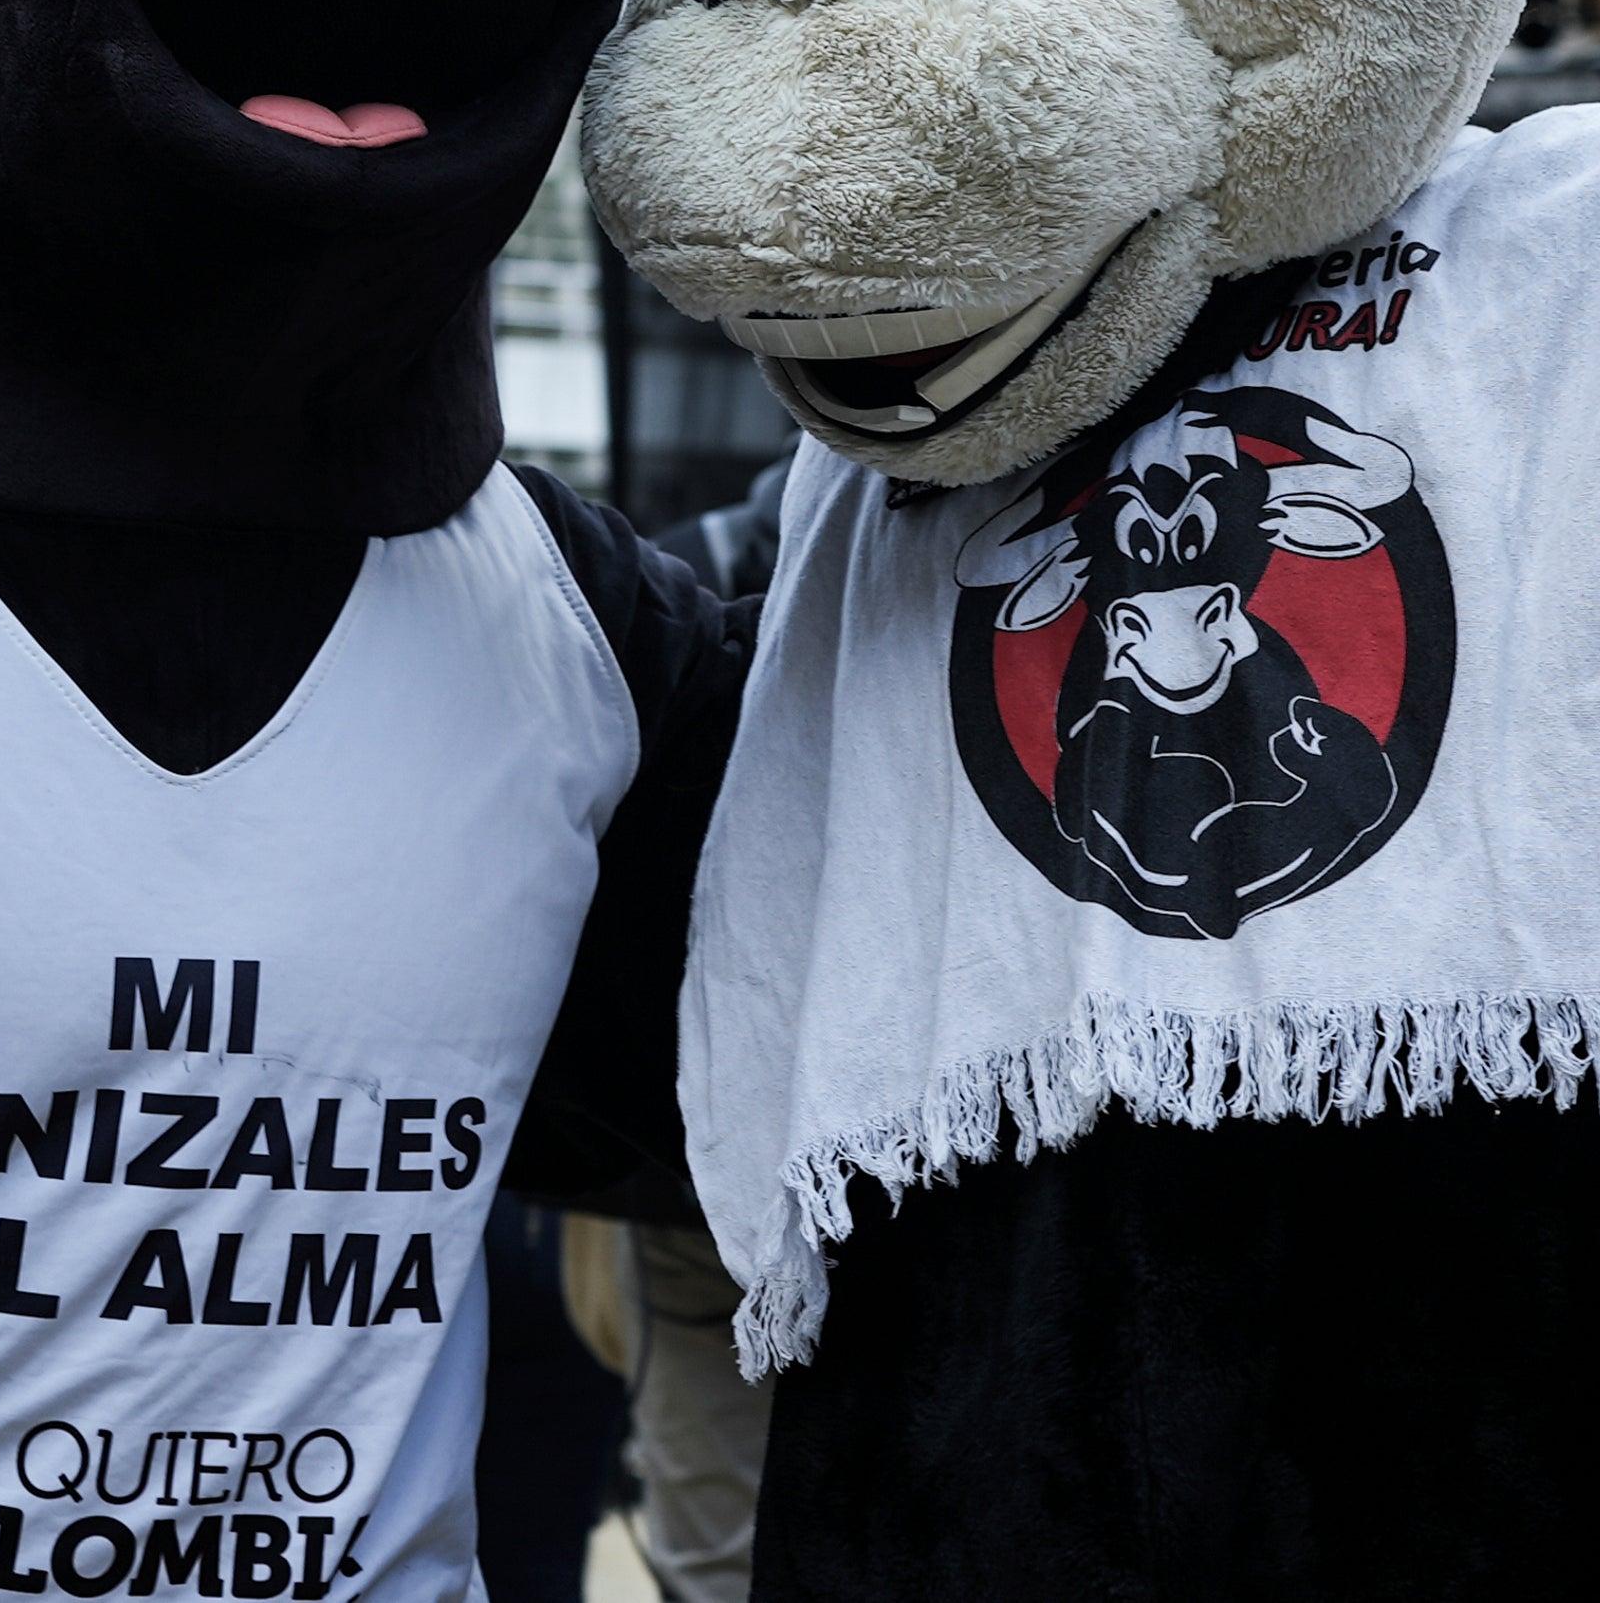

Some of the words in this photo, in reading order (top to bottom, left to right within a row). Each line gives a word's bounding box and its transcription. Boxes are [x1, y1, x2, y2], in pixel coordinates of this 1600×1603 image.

[108, 956, 261, 1055] MI
[99, 1228, 443, 1328] ALMA
[16, 1419, 355, 1506] QUIERO
